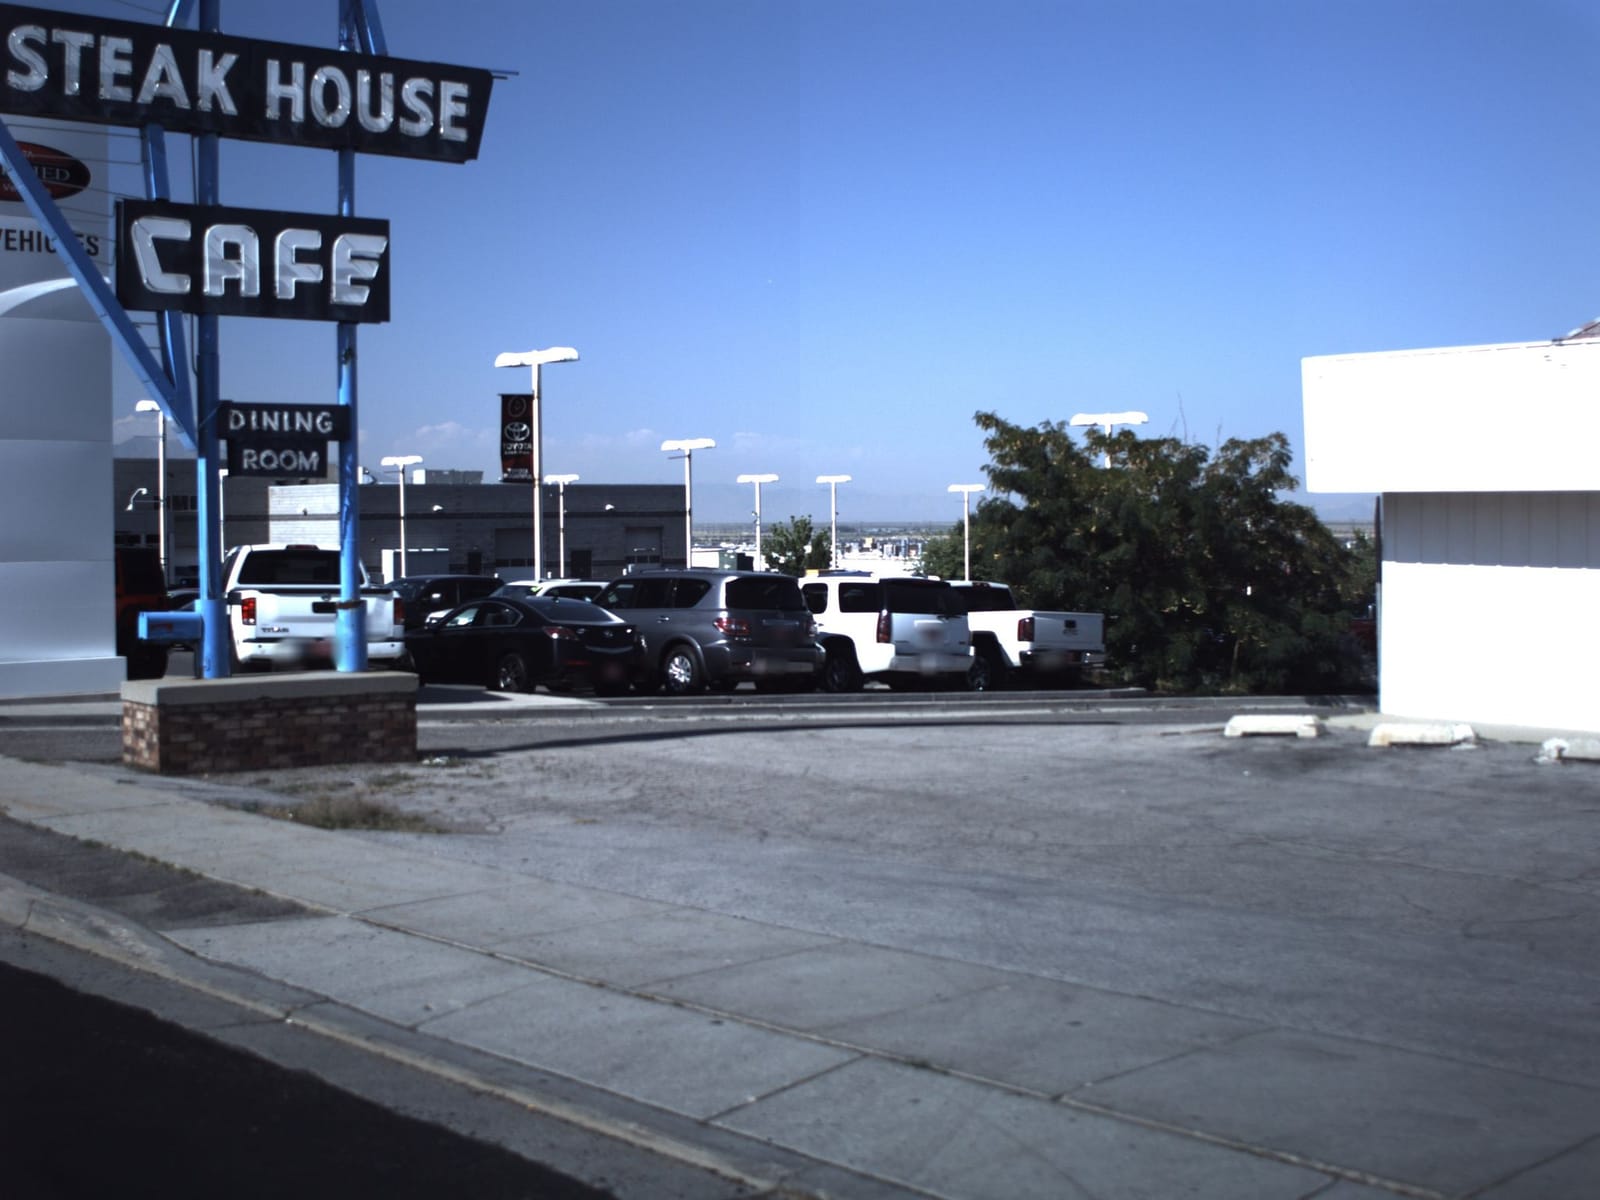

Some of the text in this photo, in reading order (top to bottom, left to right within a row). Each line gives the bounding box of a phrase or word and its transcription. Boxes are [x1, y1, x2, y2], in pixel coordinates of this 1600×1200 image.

[6, 24, 470, 142] STEAK HOUSE
[0, 228, 99, 256] EHICS
[131, 215, 388, 306] CAFE
[229, 409, 333, 433] DINING
[243, 449, 320, 471] ROOM
